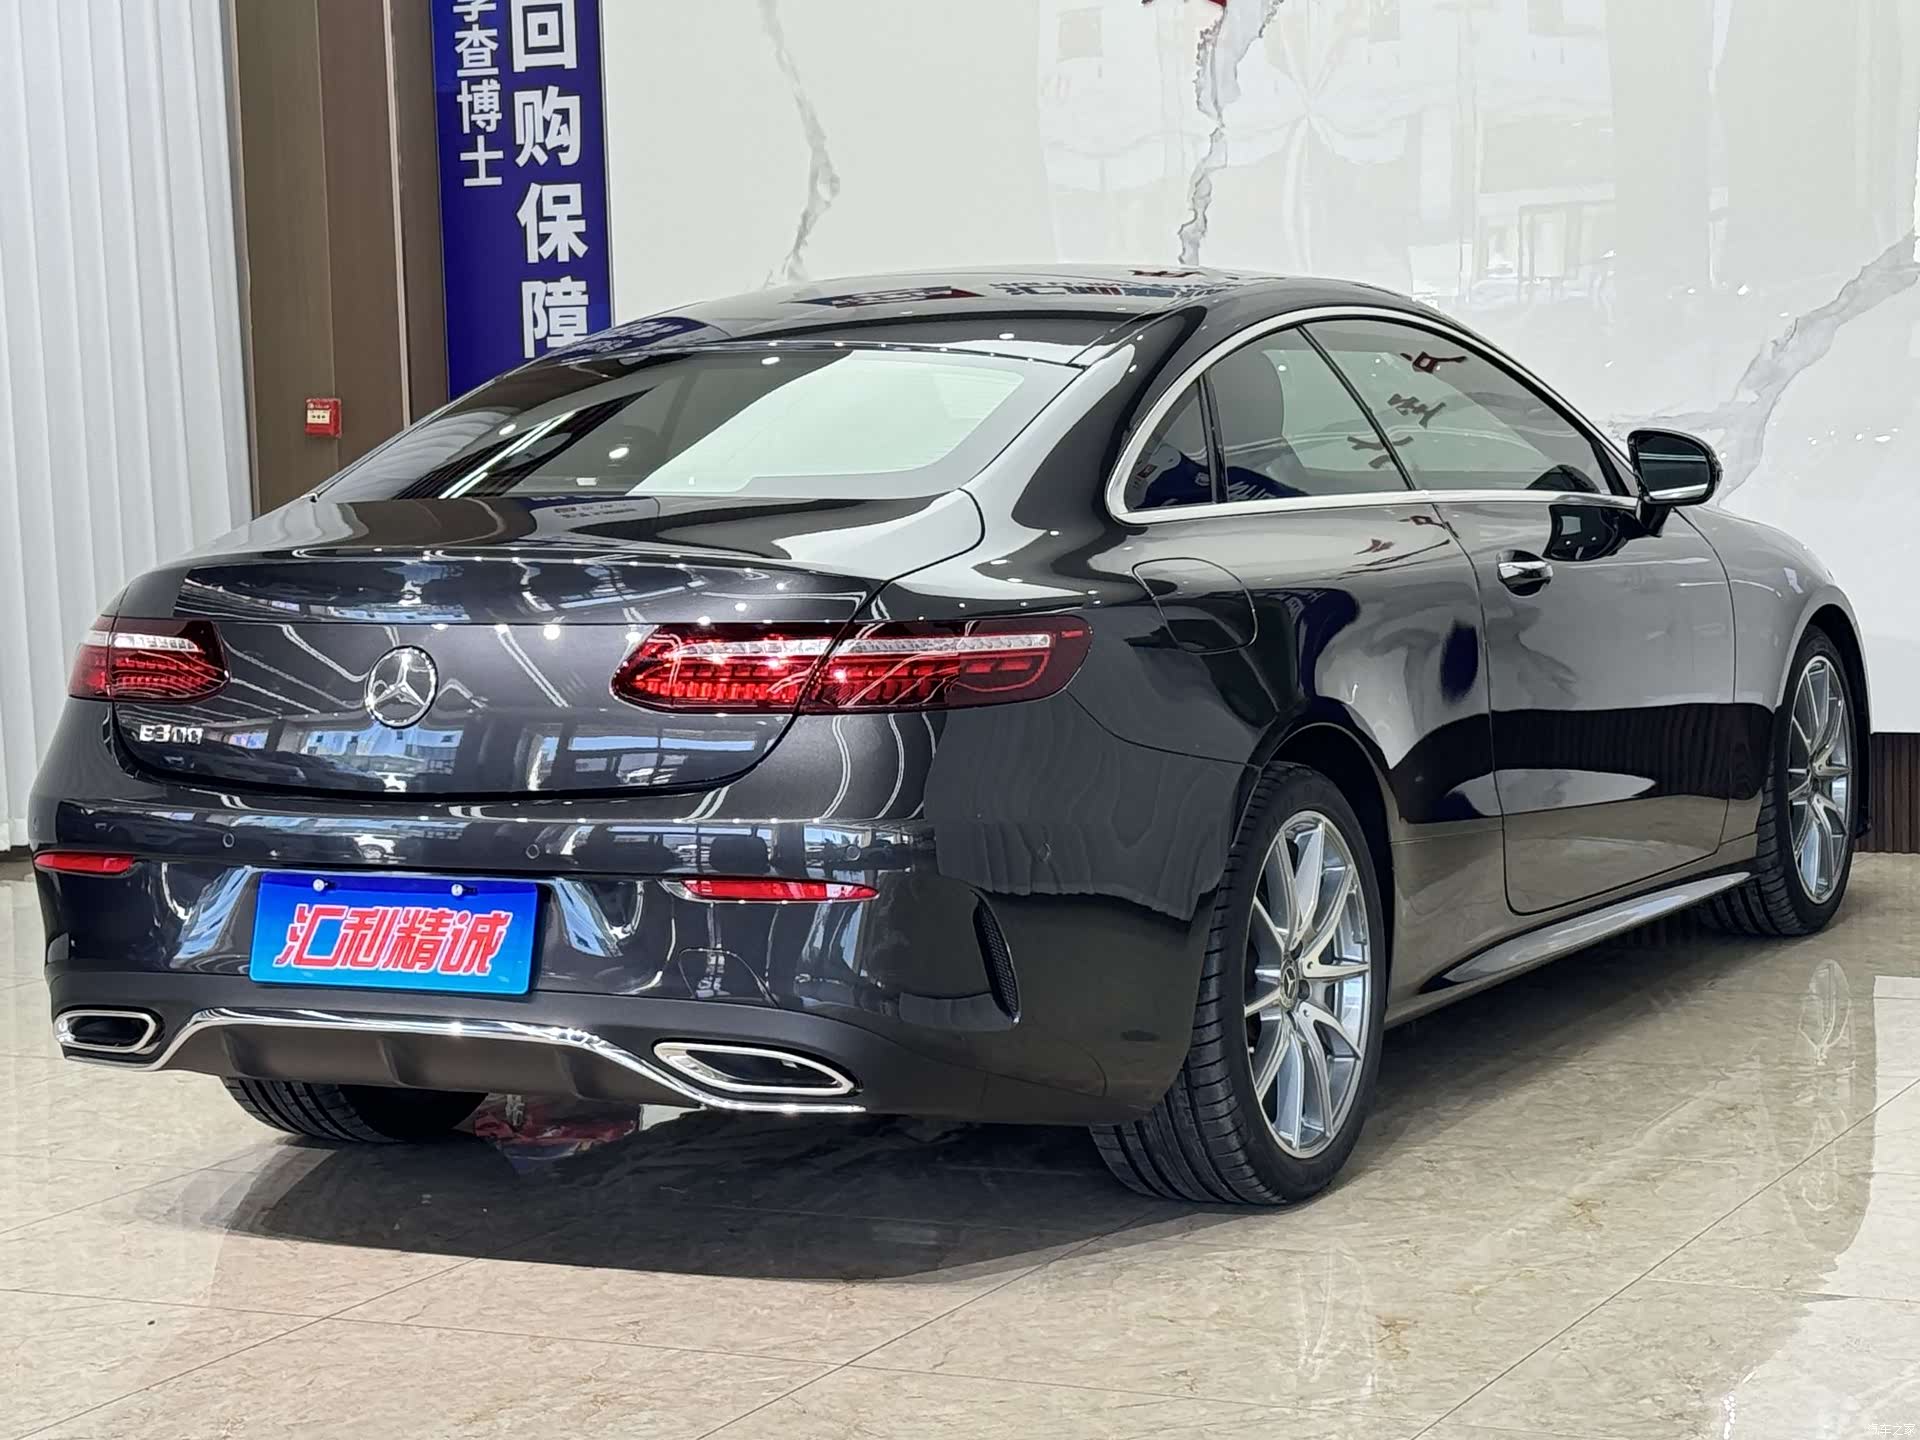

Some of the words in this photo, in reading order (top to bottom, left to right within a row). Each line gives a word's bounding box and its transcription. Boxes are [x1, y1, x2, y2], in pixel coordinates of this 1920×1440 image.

[510, 0, 589, 358] 回购保障
[273, 903, 513, 976] 汇利精诚
